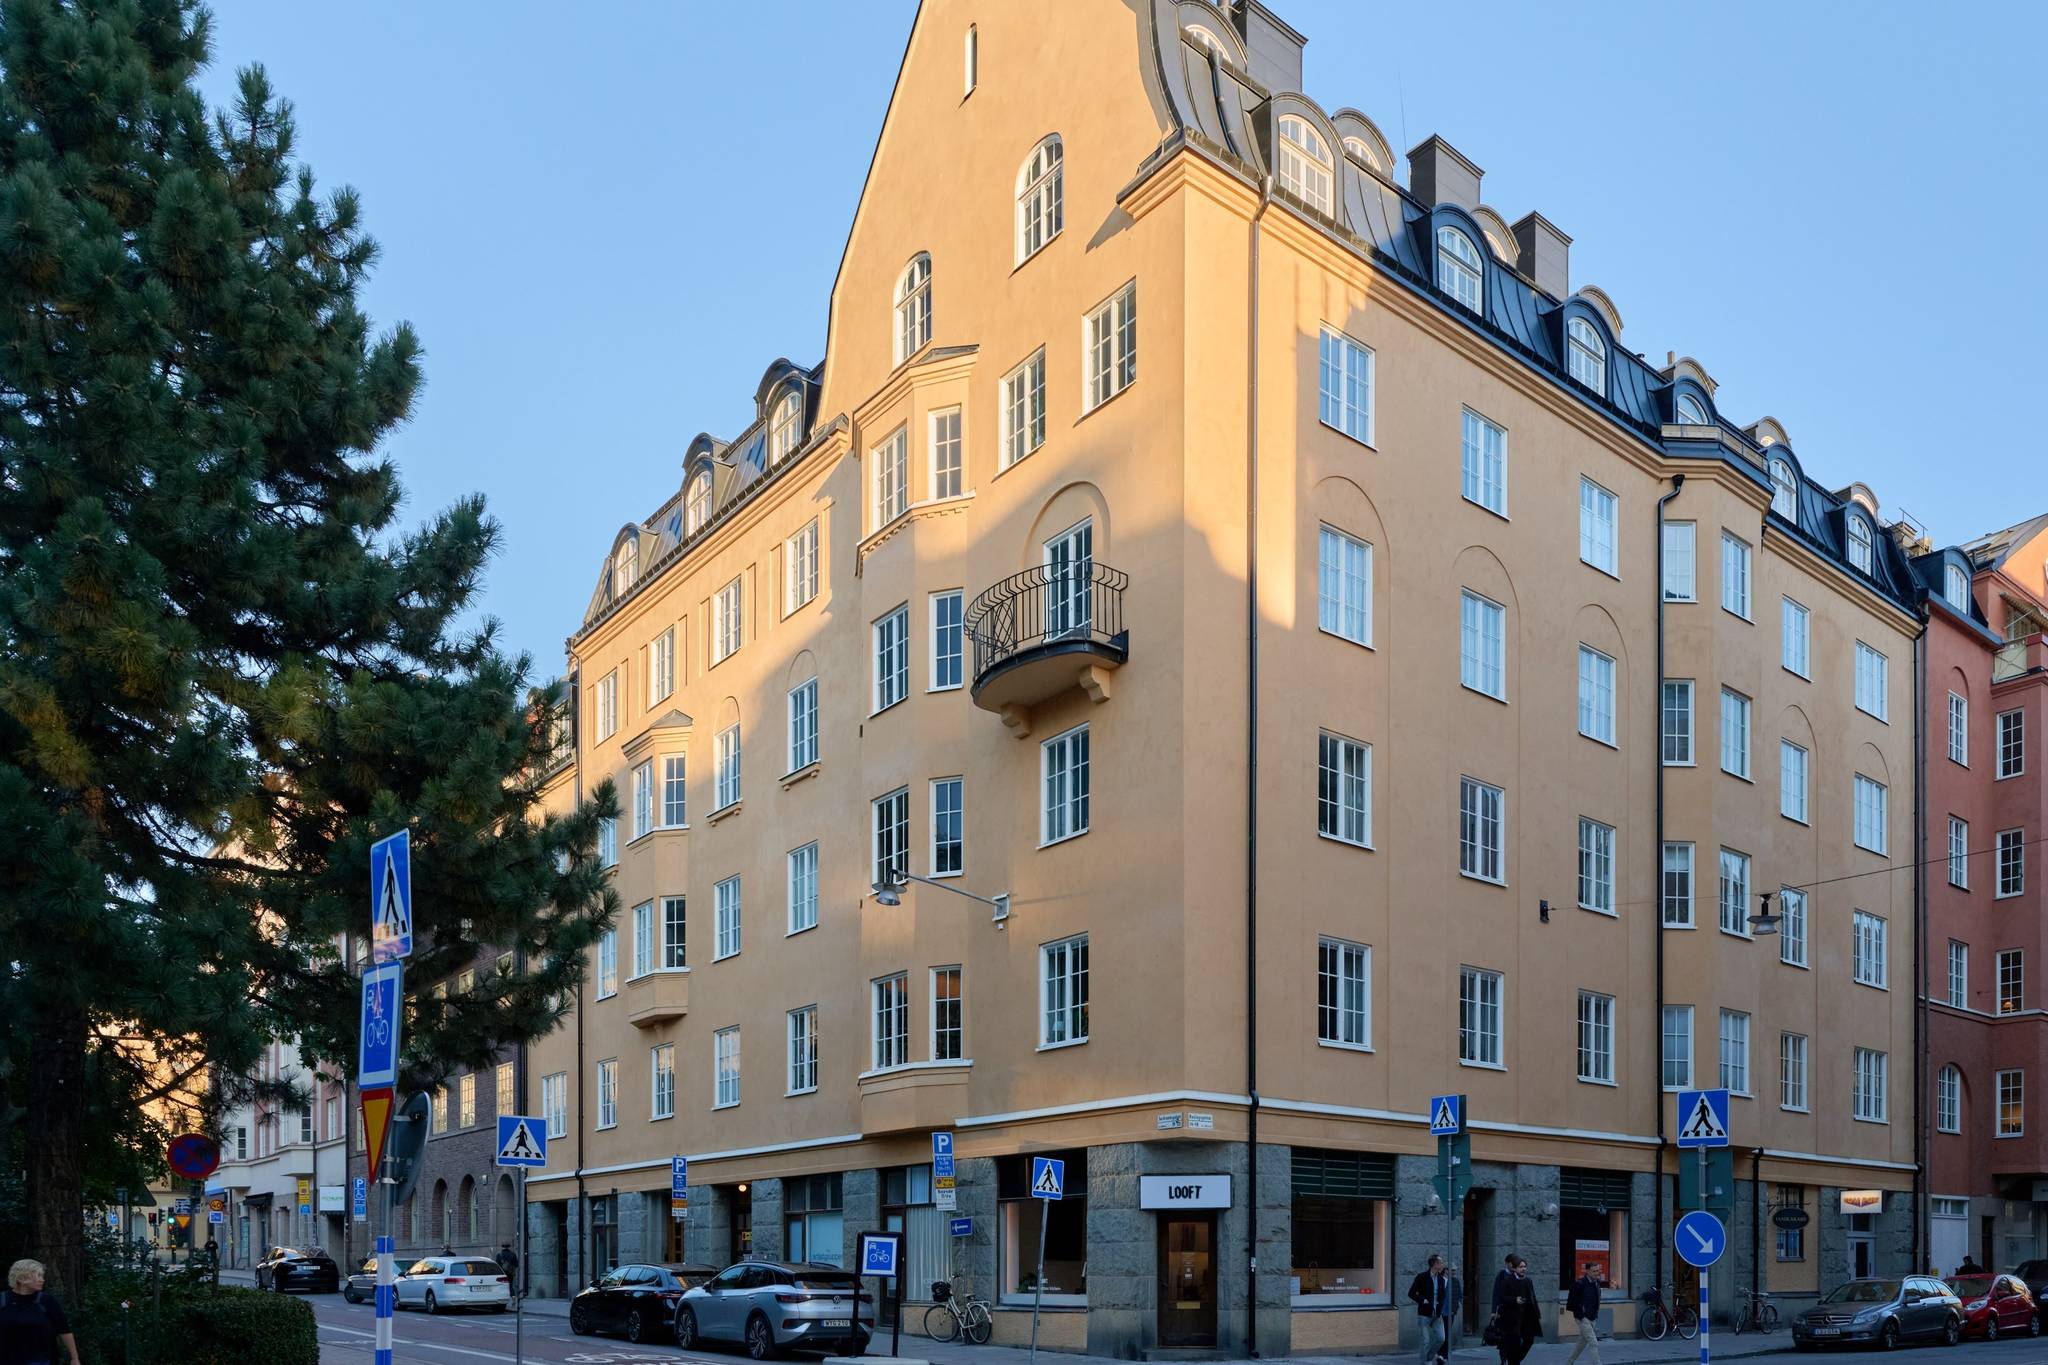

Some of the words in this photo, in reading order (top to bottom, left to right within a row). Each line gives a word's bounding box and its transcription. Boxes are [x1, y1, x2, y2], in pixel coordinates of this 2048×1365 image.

[938, 1135, 950, 1153] P
[676, 1158, 685, 1172] P
[357, 1179, 364, 1188] P
[1168, 1186, 1202, 1199] LOOFT
[211, 1201, 222, 1209] 40
